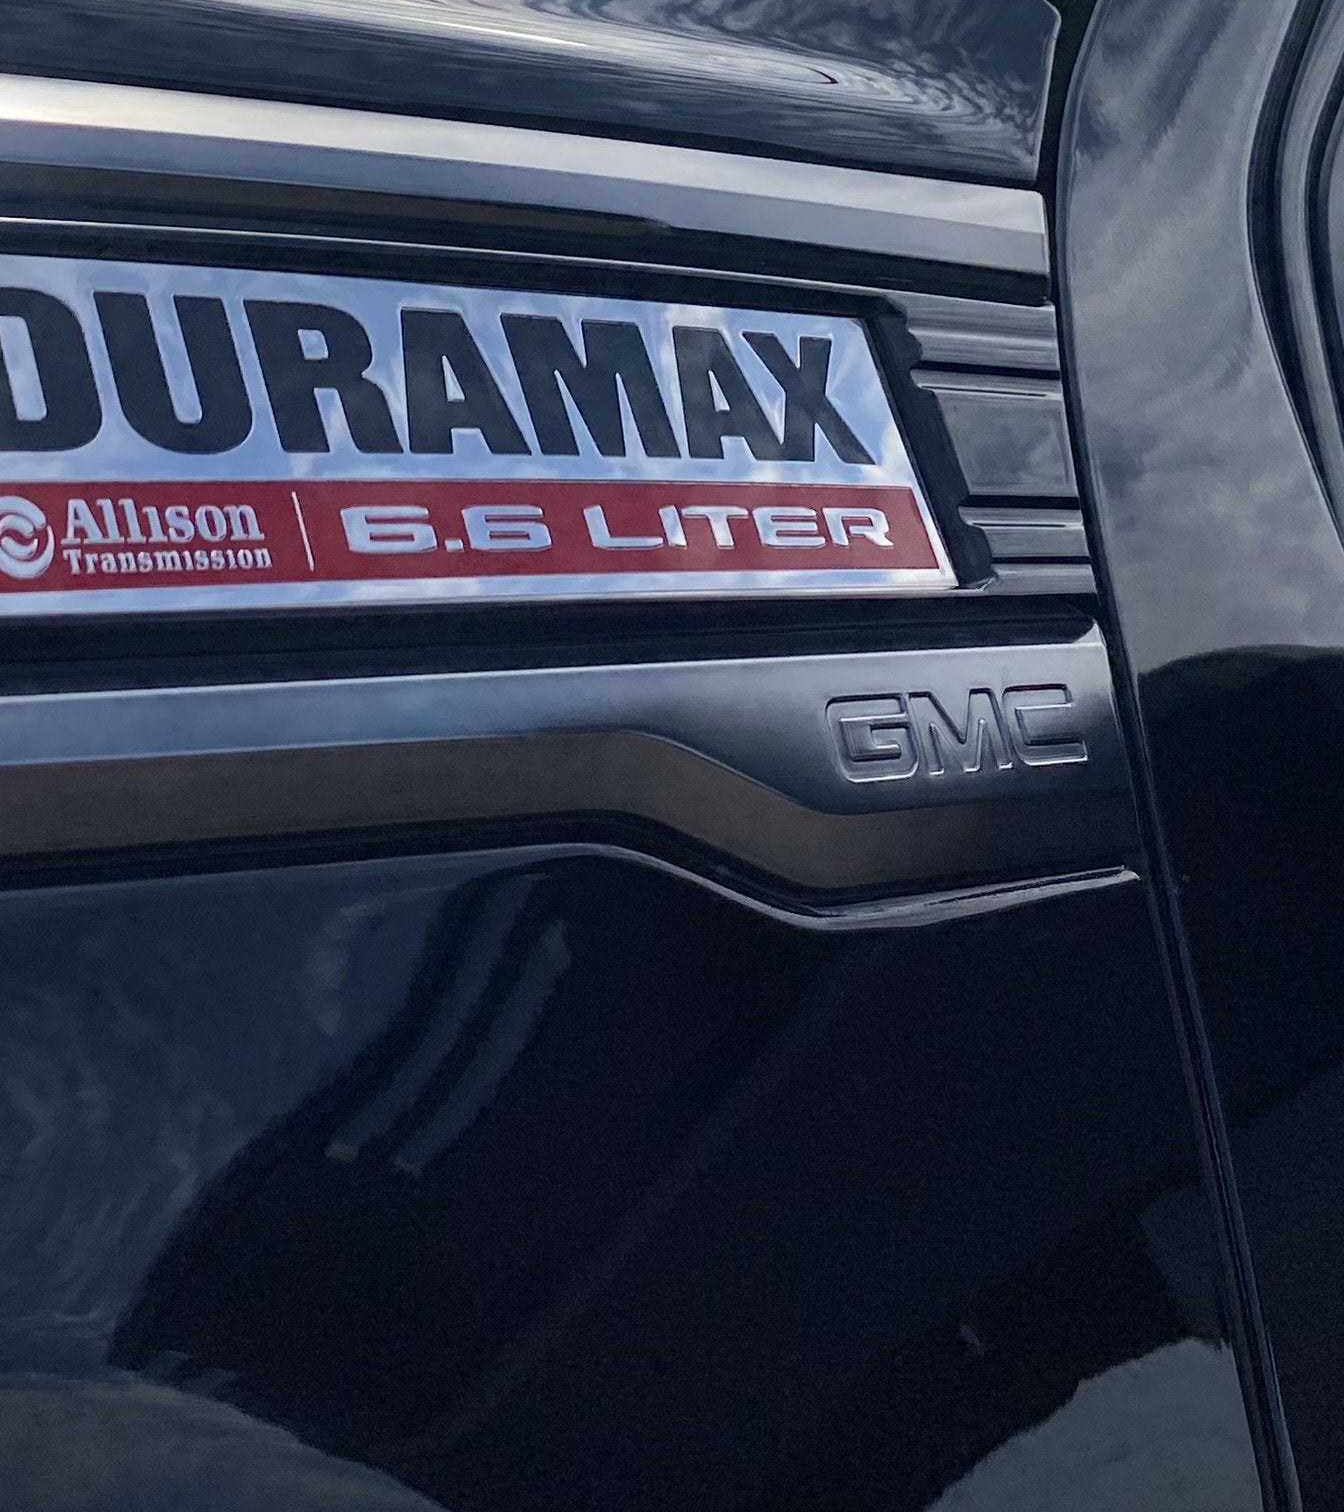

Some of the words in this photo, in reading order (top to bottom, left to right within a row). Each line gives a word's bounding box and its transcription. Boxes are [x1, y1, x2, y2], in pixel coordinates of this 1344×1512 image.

[61, 497, 265, 545] Allison
[340, 504, 552, 554] 6.6
[582, 504, 894, 551] LITER
[62, 547, 273, 576] Transmission
[824, 683, 1089, 783] GMC
